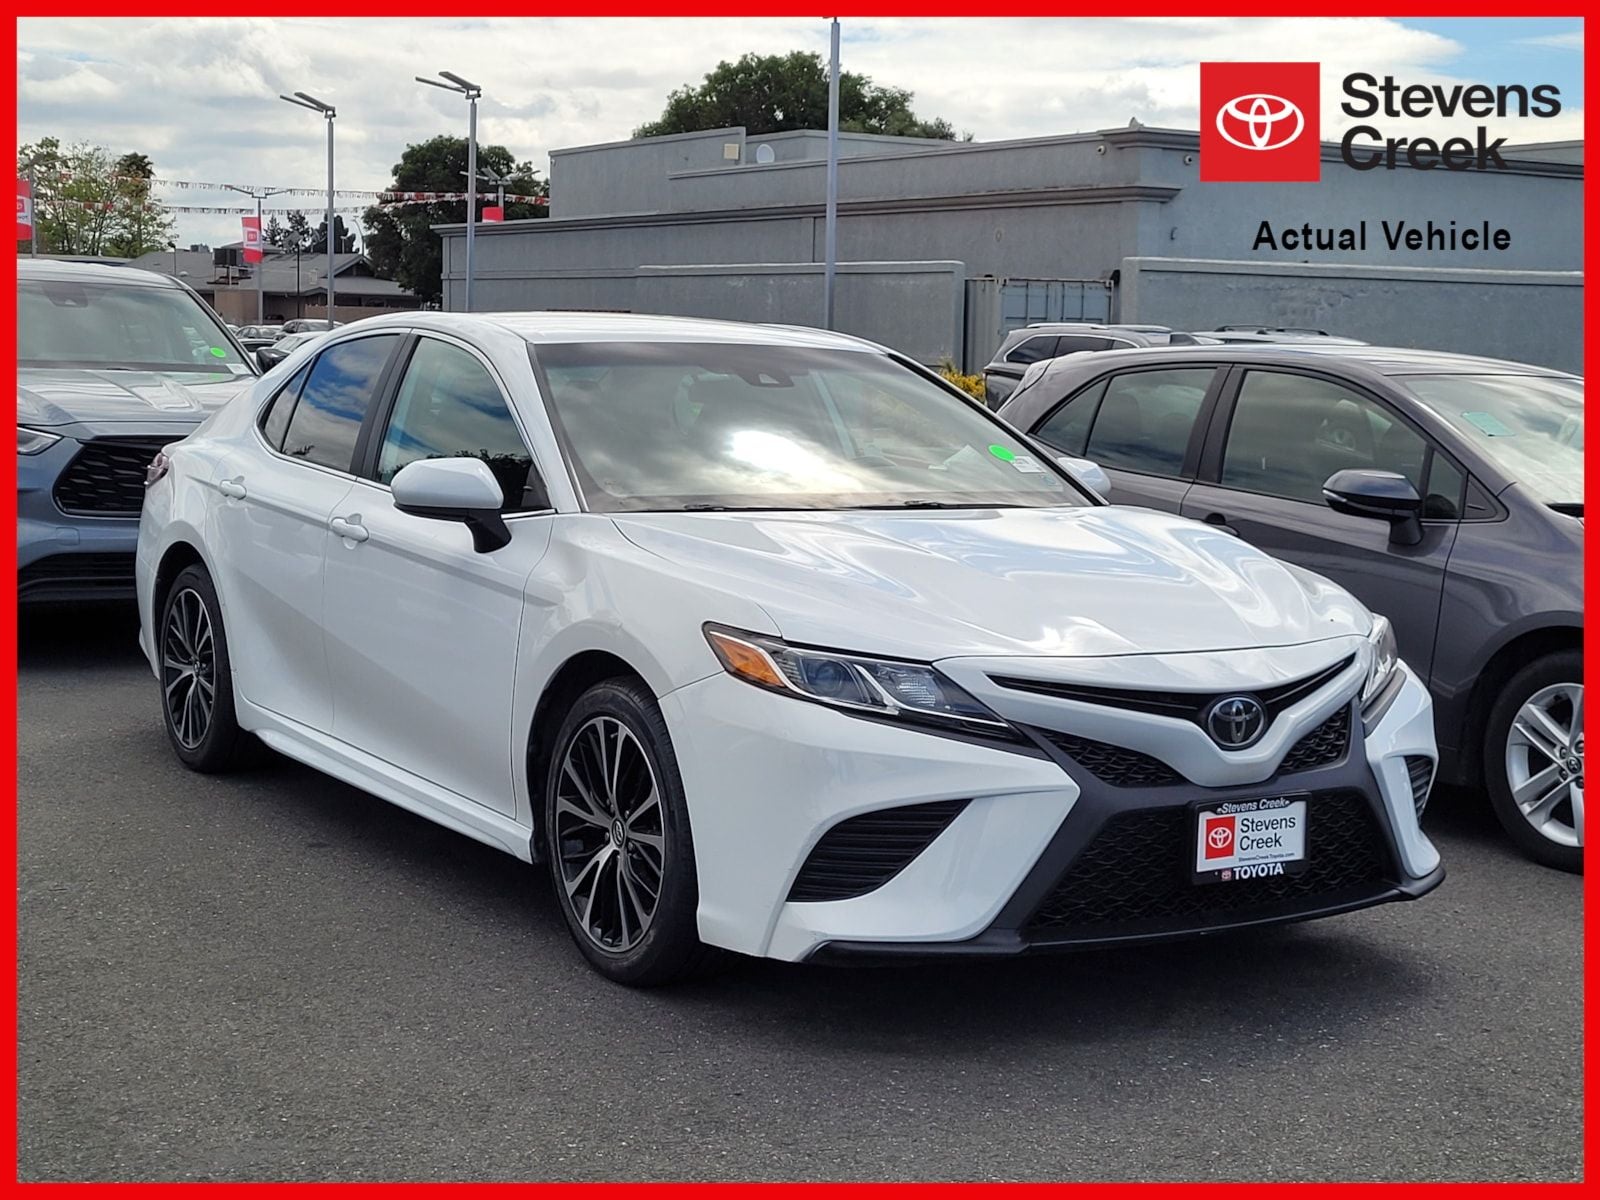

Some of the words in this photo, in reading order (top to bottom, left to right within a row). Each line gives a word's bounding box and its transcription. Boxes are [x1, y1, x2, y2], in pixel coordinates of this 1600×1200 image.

[1221, 801, 1257, 814] Stevens
[1259, 797, 1286, 809] Creek
[1240, 816, 1296, 833] Stevens
[1239, 832, 1282, 851] Creek
[1233, 862, 1284, 880] TOYOTA
